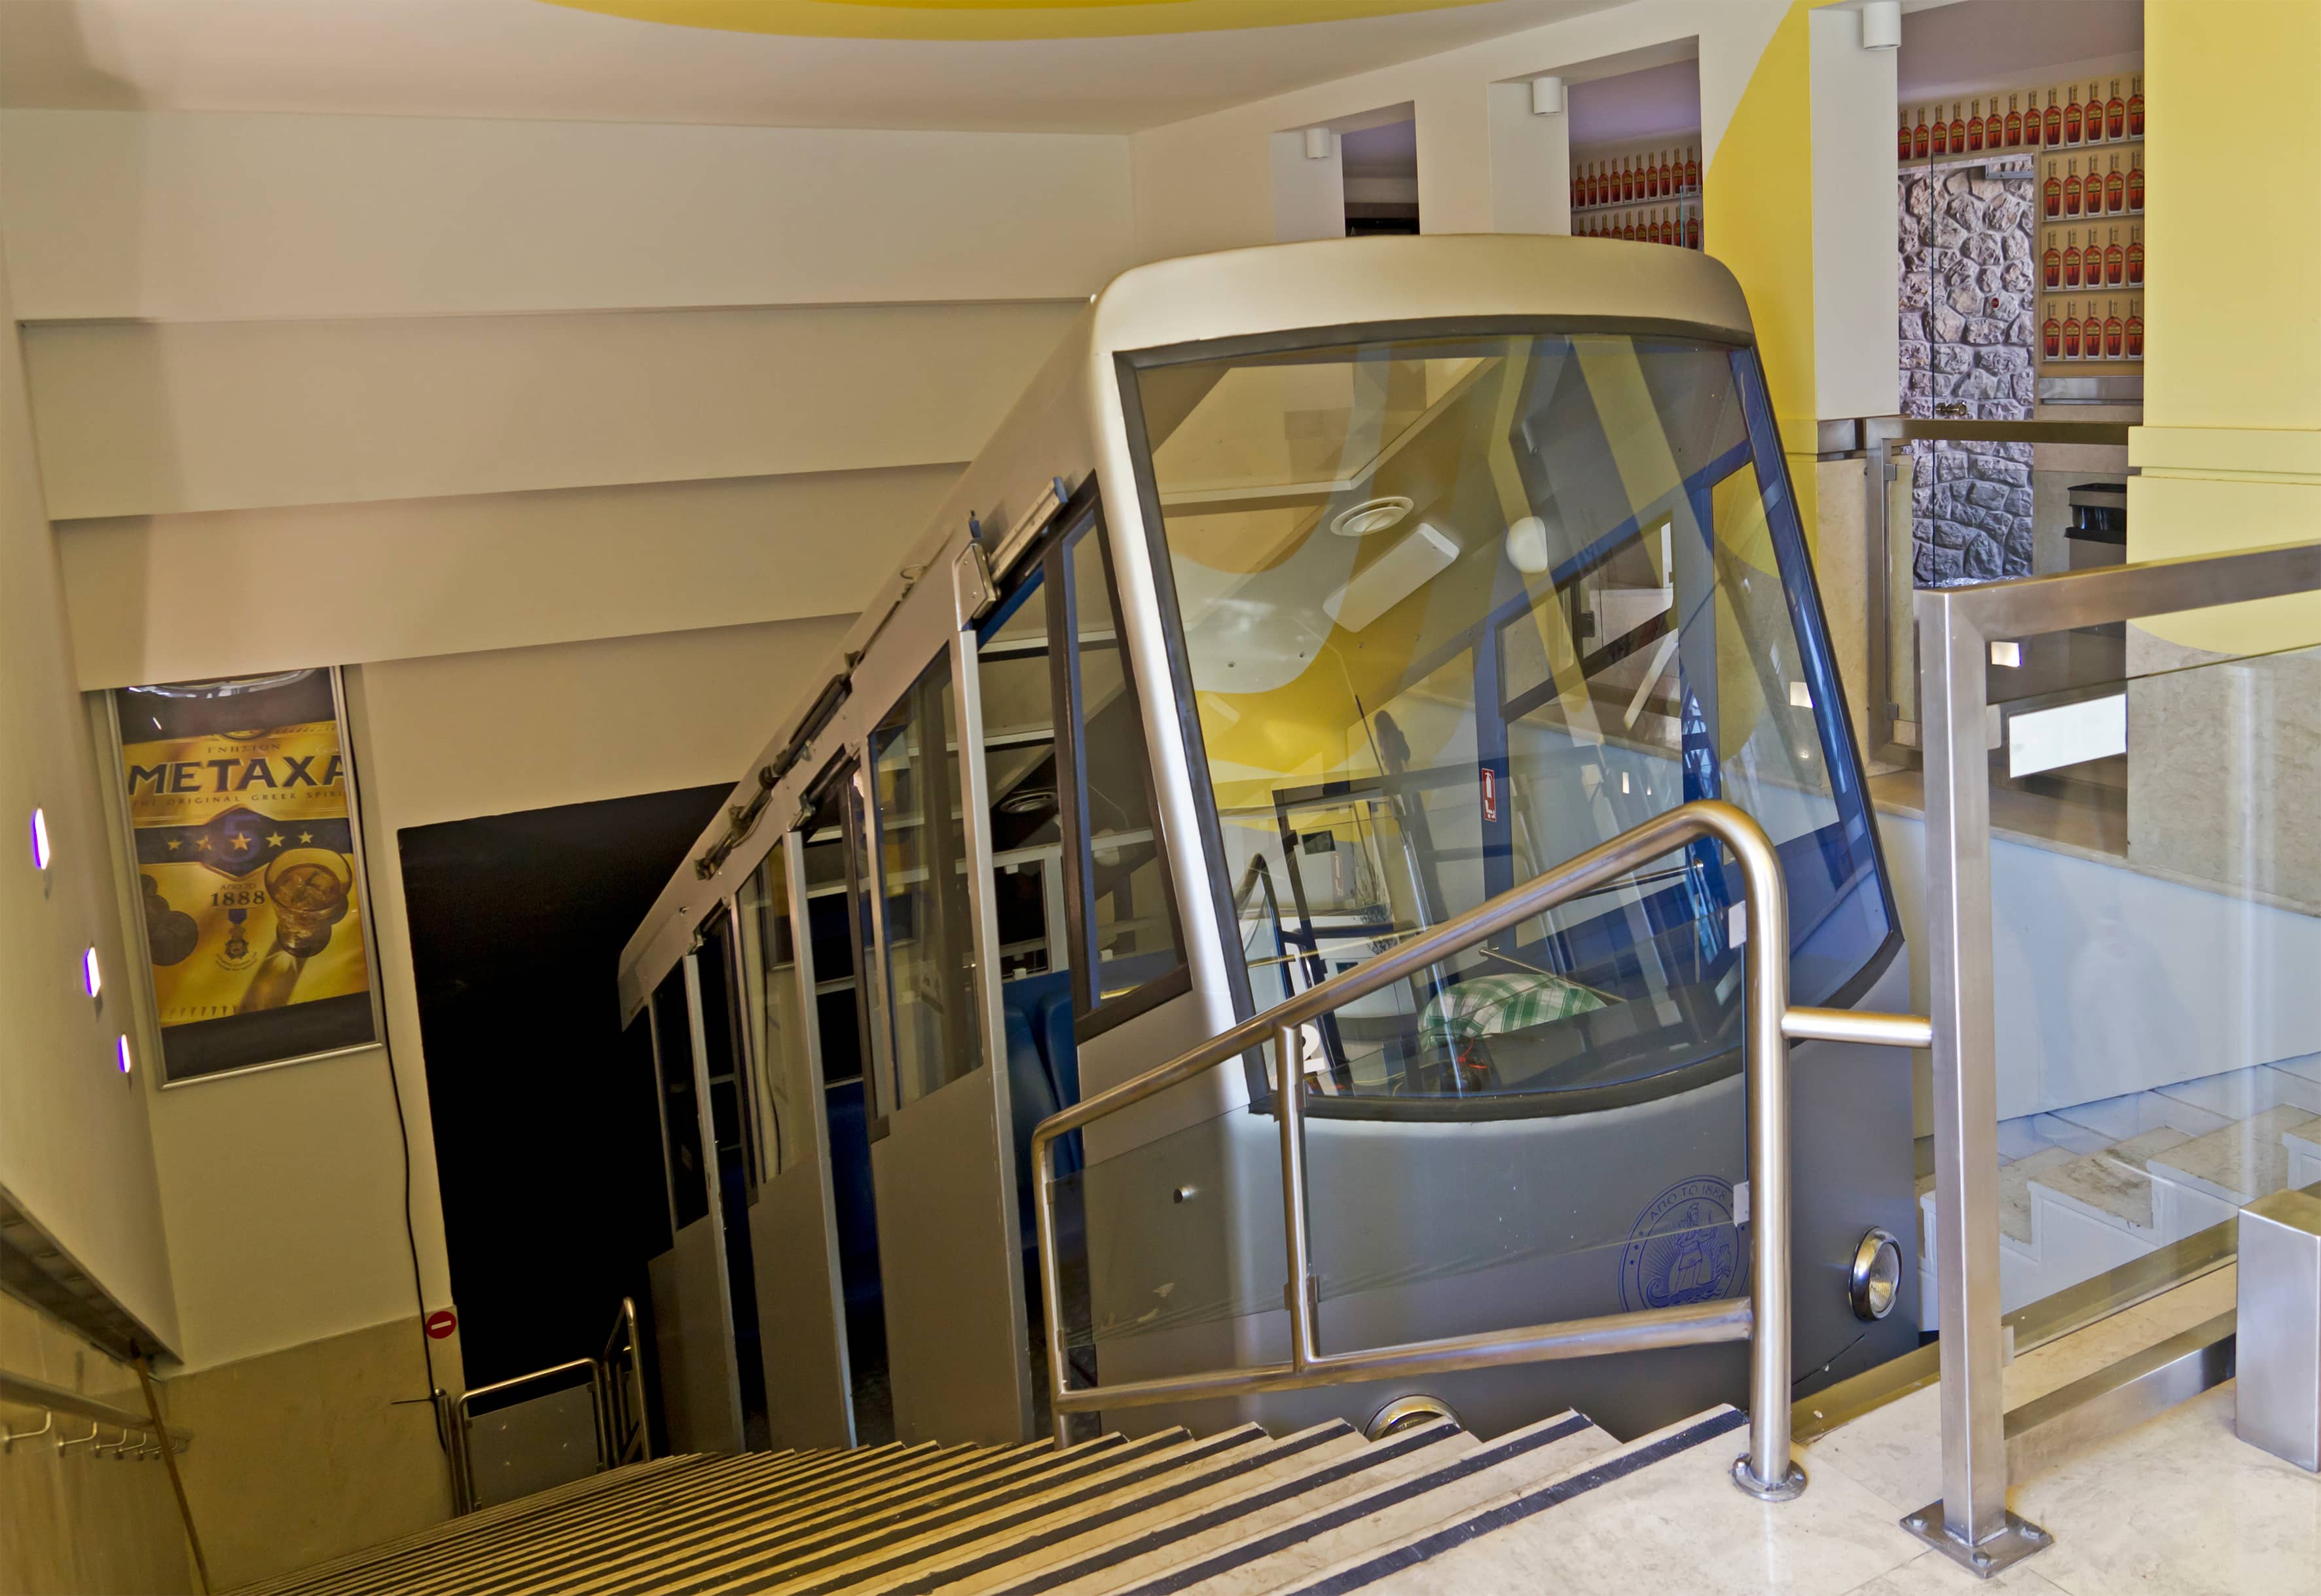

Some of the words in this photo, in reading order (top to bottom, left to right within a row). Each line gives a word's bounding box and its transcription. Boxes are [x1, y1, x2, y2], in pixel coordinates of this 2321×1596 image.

[128, 757, 344, 796] METAXA
[167, 796, 240, 805] ORIGINAL
[251, 793, 297, 801] GREEK
[210, 890, 265, 907] 1888
[1702, 1184, 1727, 1201] 1888
